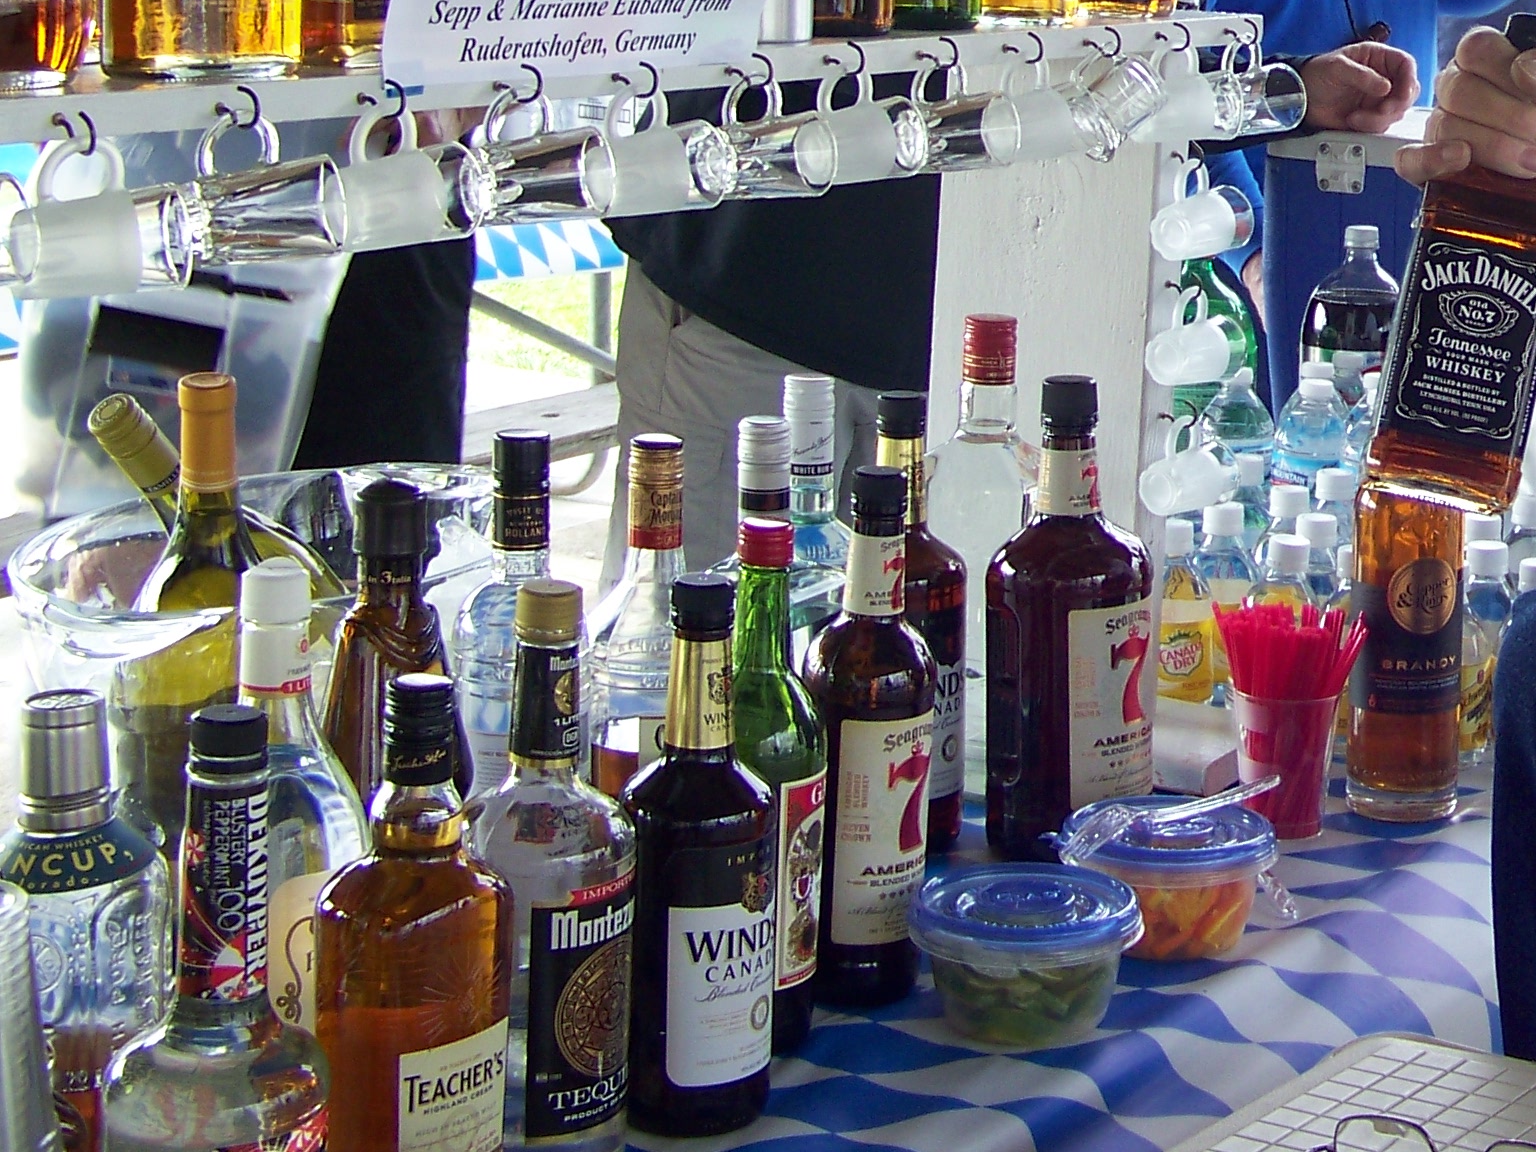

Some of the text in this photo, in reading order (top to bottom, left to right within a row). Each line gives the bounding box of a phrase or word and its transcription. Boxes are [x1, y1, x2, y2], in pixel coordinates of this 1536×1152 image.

[486, 0, 504, 23] &
[459, 28, 697, 64] Ruderatshofen, Germany
[1421, 260, 1473, 292] JACK
[1457, 305, 1497, 324] No.7
[1469, 299, 1489, 310] Old
[1428, 327, 1511, 362] Tennessee
[1425, 355, 1506, 384] WHISKEY
[1412, 380, 1508, 407] JACK DANIEL DISTILLERY
[793, 464, 816, 475] WHITE
[1396, 592, 1411, 609] &
[1172, 657, 1197, 670] DRY
[1382, 655, 1457, 671] BRANDY
[1110, 631, 1150, 727] 7
[887, 751, 932, 855] 7
[54, 833, 104, 851] WHISKEY
[231, 798, 247, 866] BLUSTERY
[213, 800, 246, 932] PEPPERMINT 100
[247, 788, 270, 978] DEKUYPER
[869, 873, 910, 888] BLENDED
[403, 1049, 504, 1113] TEACHER'S
[423, 1084, 494, 1116] HIGHLAND CREAM
[563, 1102, 608, 1123] PRODUCT
